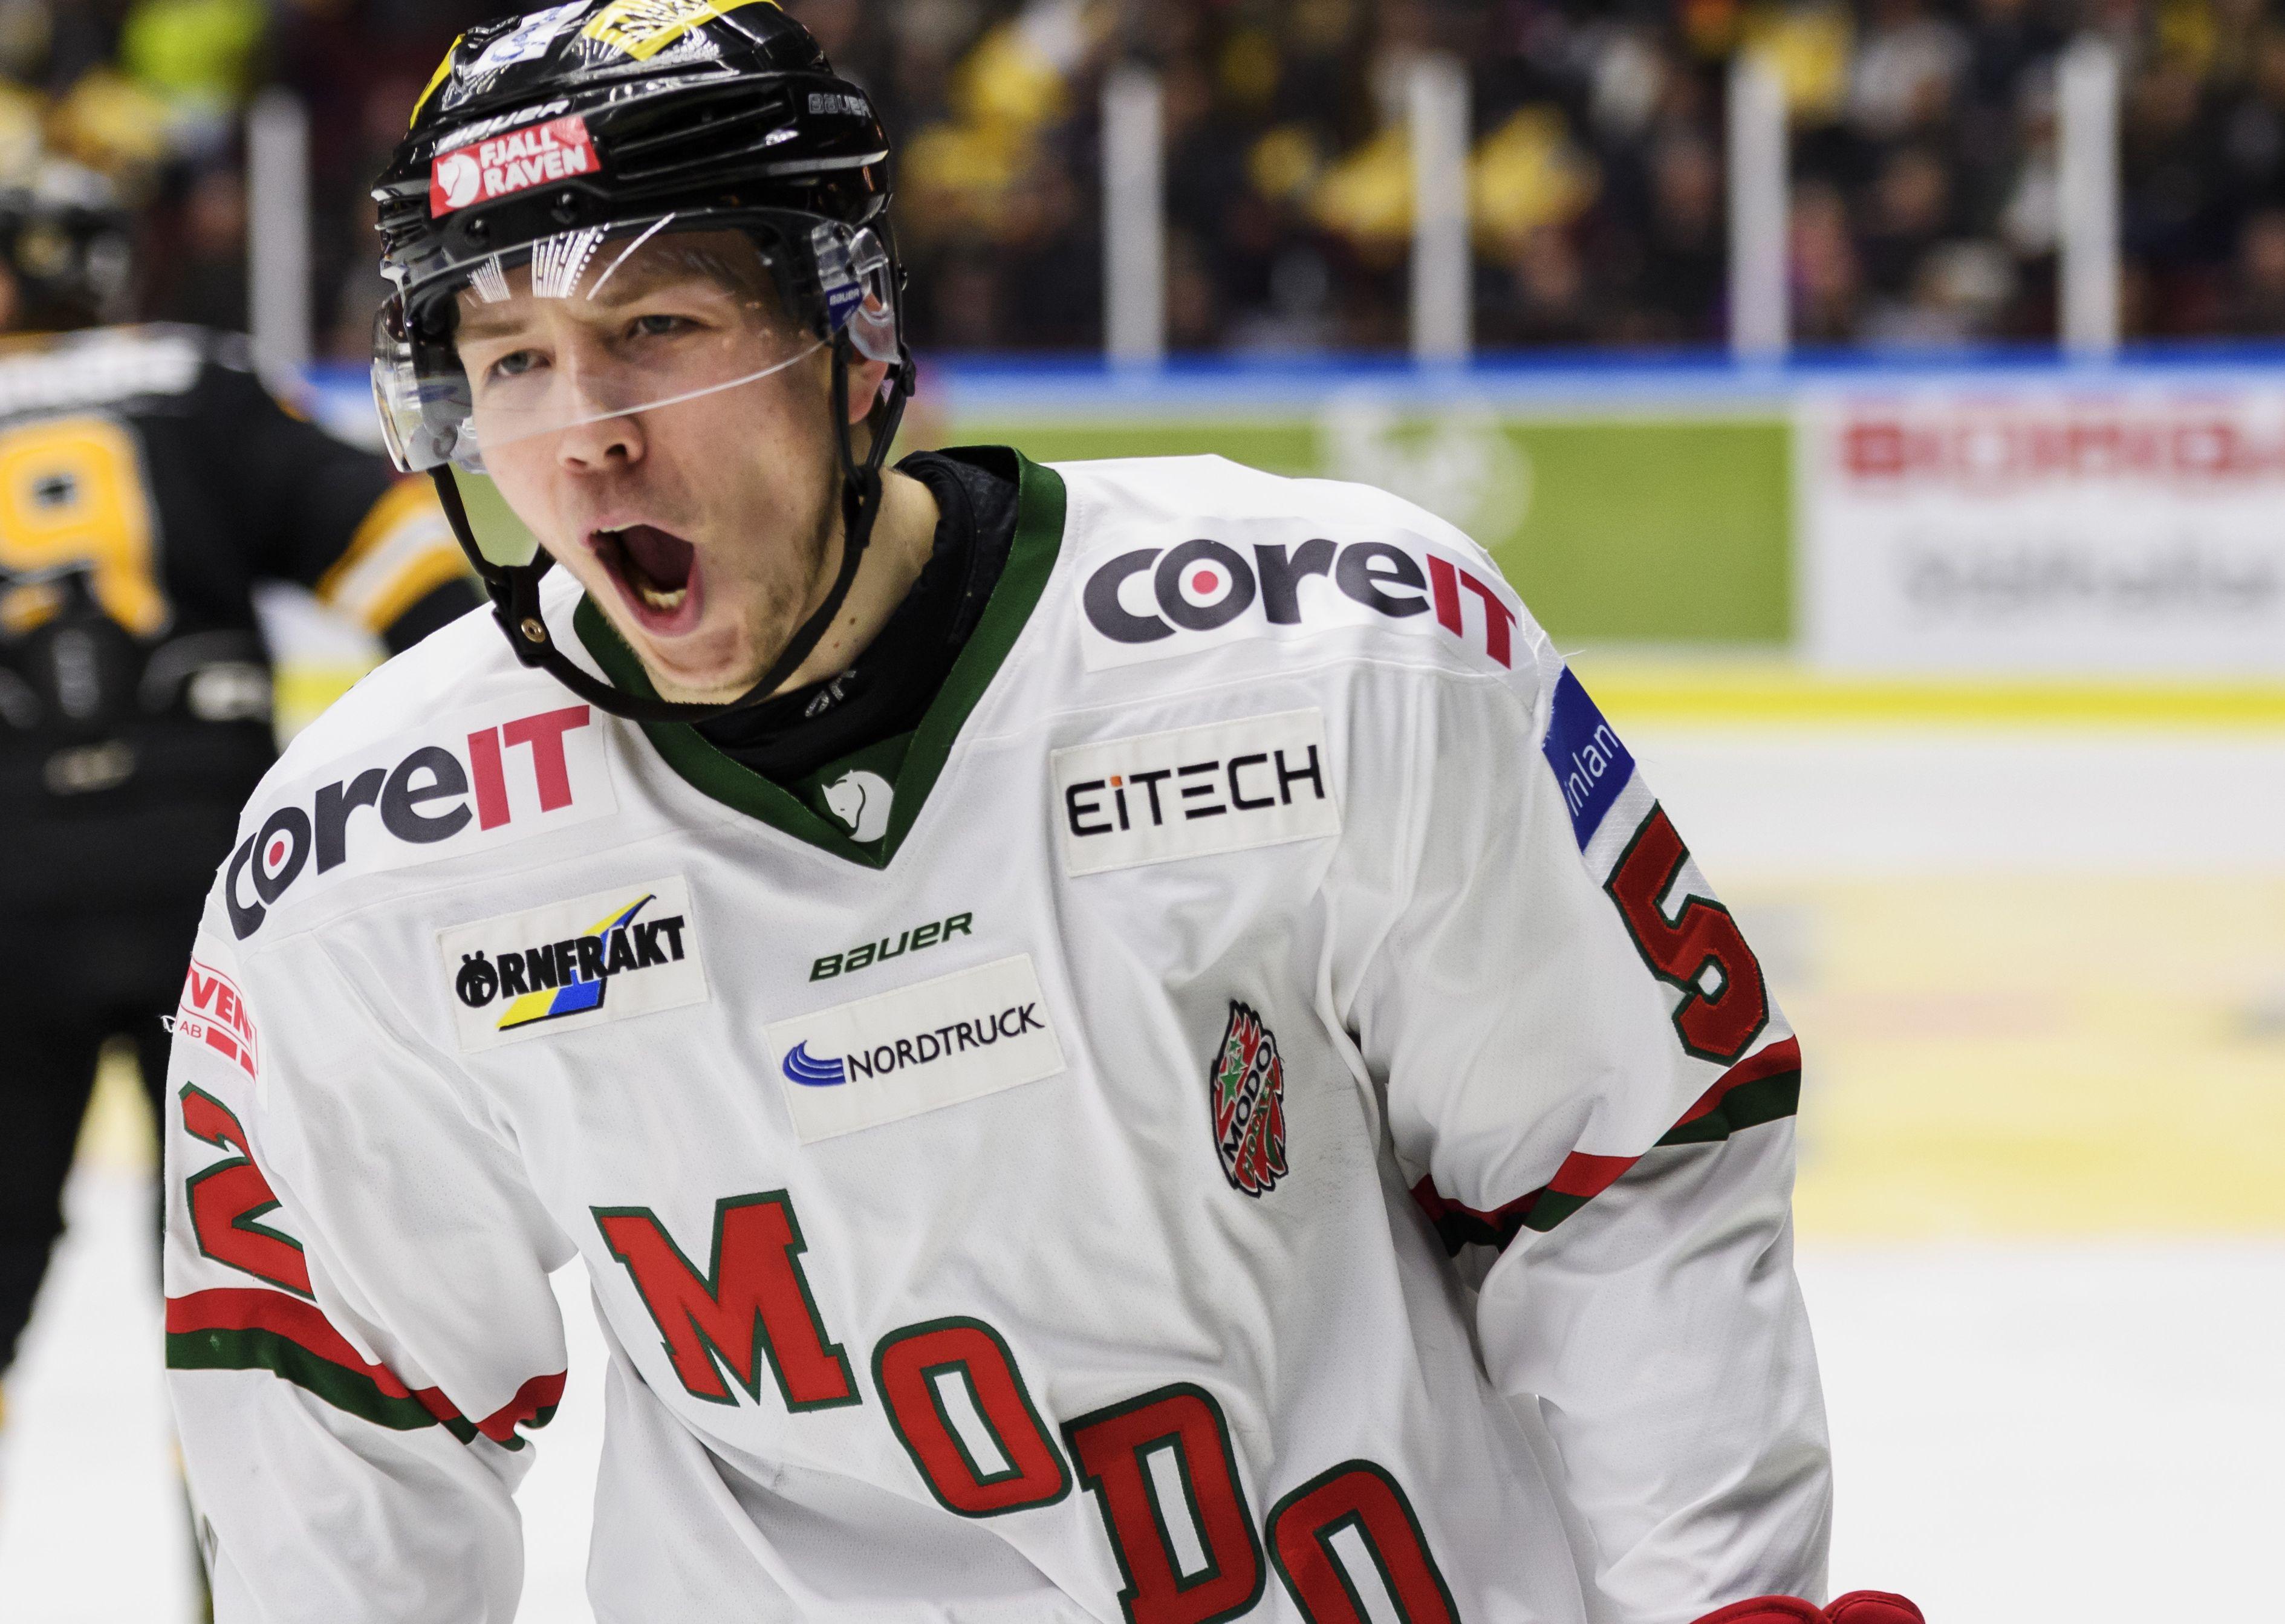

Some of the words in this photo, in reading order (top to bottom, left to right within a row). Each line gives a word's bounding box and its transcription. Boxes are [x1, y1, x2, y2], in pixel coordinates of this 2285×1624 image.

[479, 126, 559, 168] FJÄLL
[484, 145, 587, 197] RÄVEN
[1083, 538, 1519, 671] coreIT
[226, 704, 590, 941] coreIT
[455, 914, 686, 1009] ÖRNFRAKT
[1603, 799, 1770, 1068] 5
[847, 1001, 1045, 1083] NORDTRUCK
[1223, 1041, 1272, 1163] MODO
[589, 1187, 1463, 1624] MODO
